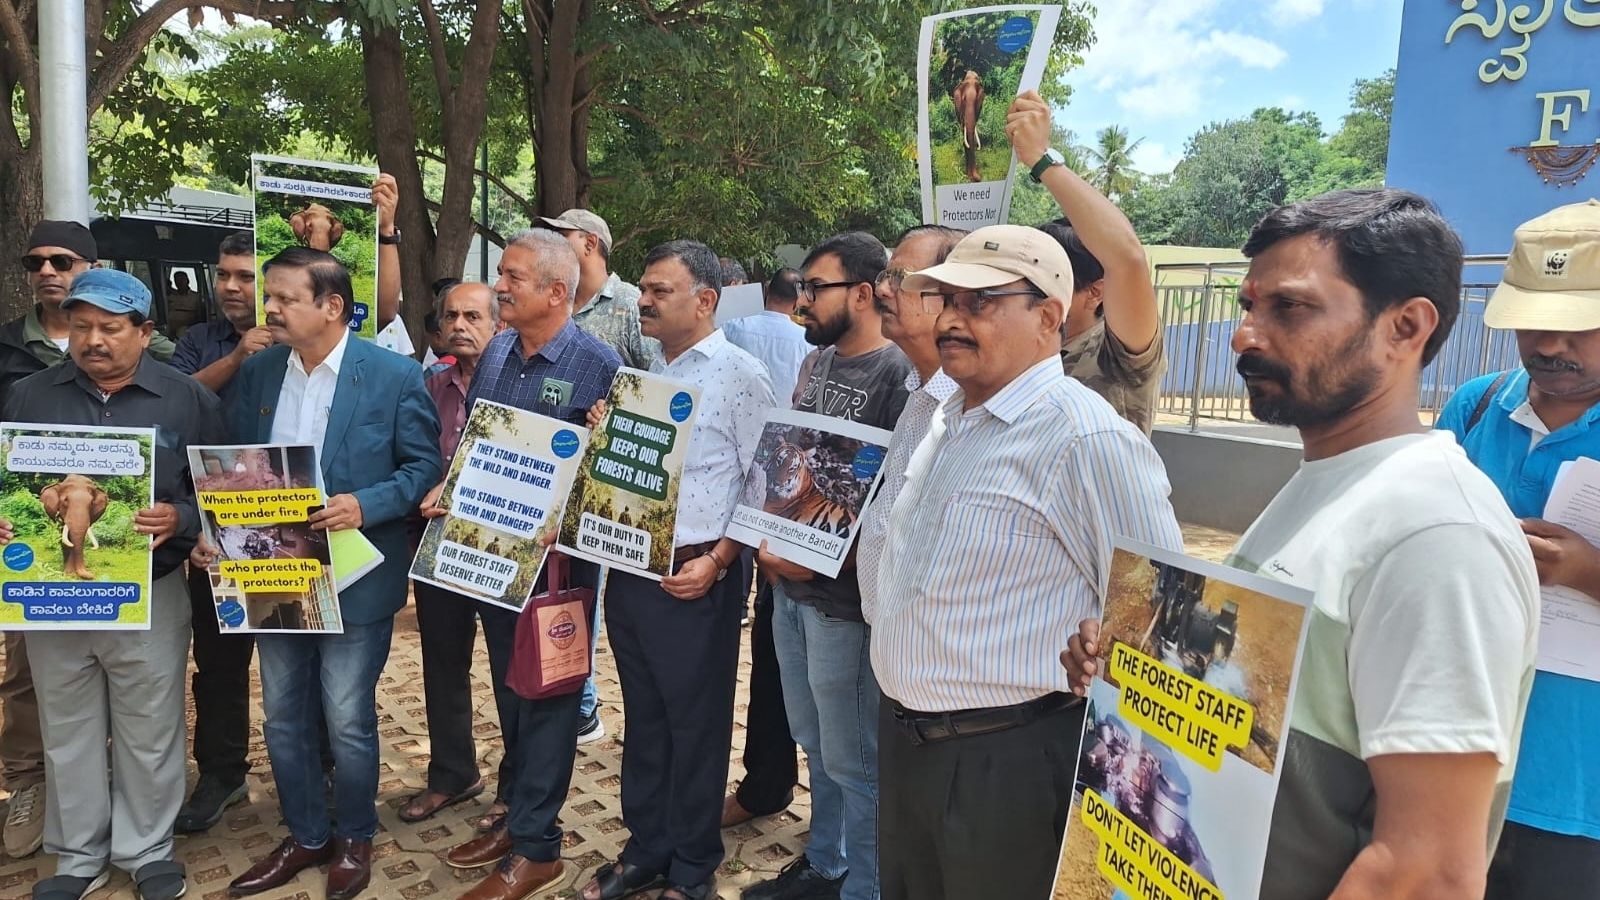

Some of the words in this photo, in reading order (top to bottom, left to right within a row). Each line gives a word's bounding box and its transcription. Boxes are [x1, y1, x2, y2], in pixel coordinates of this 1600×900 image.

[953, 189, 968, 201] We
[970, 186, 990, 200] need
[943, 209, 984, 221] Protectors
[611, 415, 633, 434] THEIR
[633, 421, 671, 446] COURAGE
[18, 442, 45, 450] ಕಾಡು
[99, 444, 135, 457] ಅದನ್ನು
[476, 443, 494, 455] THEY
[494, 448, 518, 463] STAND
[520, 455, 555, 475] BETWEEN
[610, 436, 637, 459] KEEPS
[639, 446, 660, 466] OUR
[469, 457, 481, 468] THE
[482, 460, 500, 475] WILD
[502, 466, 518, 480] AND
[520, 472, 552, 491] DANGER.
[595, 456, 633, 483] FORESTS
[634, 468, 664, 493] ALIVE
[202, 493, 233, 504] When
[236, 493, 254, 504] the
[257, 492, 317, 505] protectors
[459, 486, 475, 499] WHO
[477, 490, 506, 509] STANDS
[508, 500, 544, 520] BETWEEN
[220, 510, 239, 520] are
[242, 508, 276, 519] under
[458, 502, 479, 517] THEM
[480, 507, 496, 522] AND
[498, 513, 534, 533] DANGER?
[583, 517, 597, 532] IT'S
[598, 522, 612, 537] OUR
[614, 528, 633, 542] DUTY
[634, 534, 645, 546] TO
[750, 516, 758, 524] not
[759, 518, 779, 532] create
[780, 524, 808, 541] another
[808, 533, 839, 553] Bandit
[441, 545, 457, 559] OUR
[458, 550, 487, 568] FOREST
[489, 559, 514, 577] STAFF
[581, 534, 600, 548] KEEP
[601, 540, 623, 557] THEM
[625, 547, 645, 563] SAFE
[225, 562, 250, 573] who
[253, 561, 298, 574] protects
[300, 561, 317, 572] the
[243, 576, 305, 589] protectors?
[440, 562, 473, 582] DESERVE
[474, 572, 504, 591] BETTER
[8, 585, 45, 597] ಕಾಡಿನ
[49, 586, 135, 598] ಕಾವಲುಗಾರರಿಗೆ
[29, 605, 73, 615] ಕಾವಲು
[77, 604, 114, 615] ಬೇಕಿದೆ
[1116, 649, 1139, 676] THE
[1140, 661, 1193, 705] FOREST
[1194, 690, 1245, 730] STAFF
[1124, 689, 1185, 736] PROTECT
[1187, 725, 1219, 757] LIFE
[1086, 795, 1126, 836] DON'T
[1124, 829, 1146, 856] LET
[1105, 843, 1134, 885] TAKE
